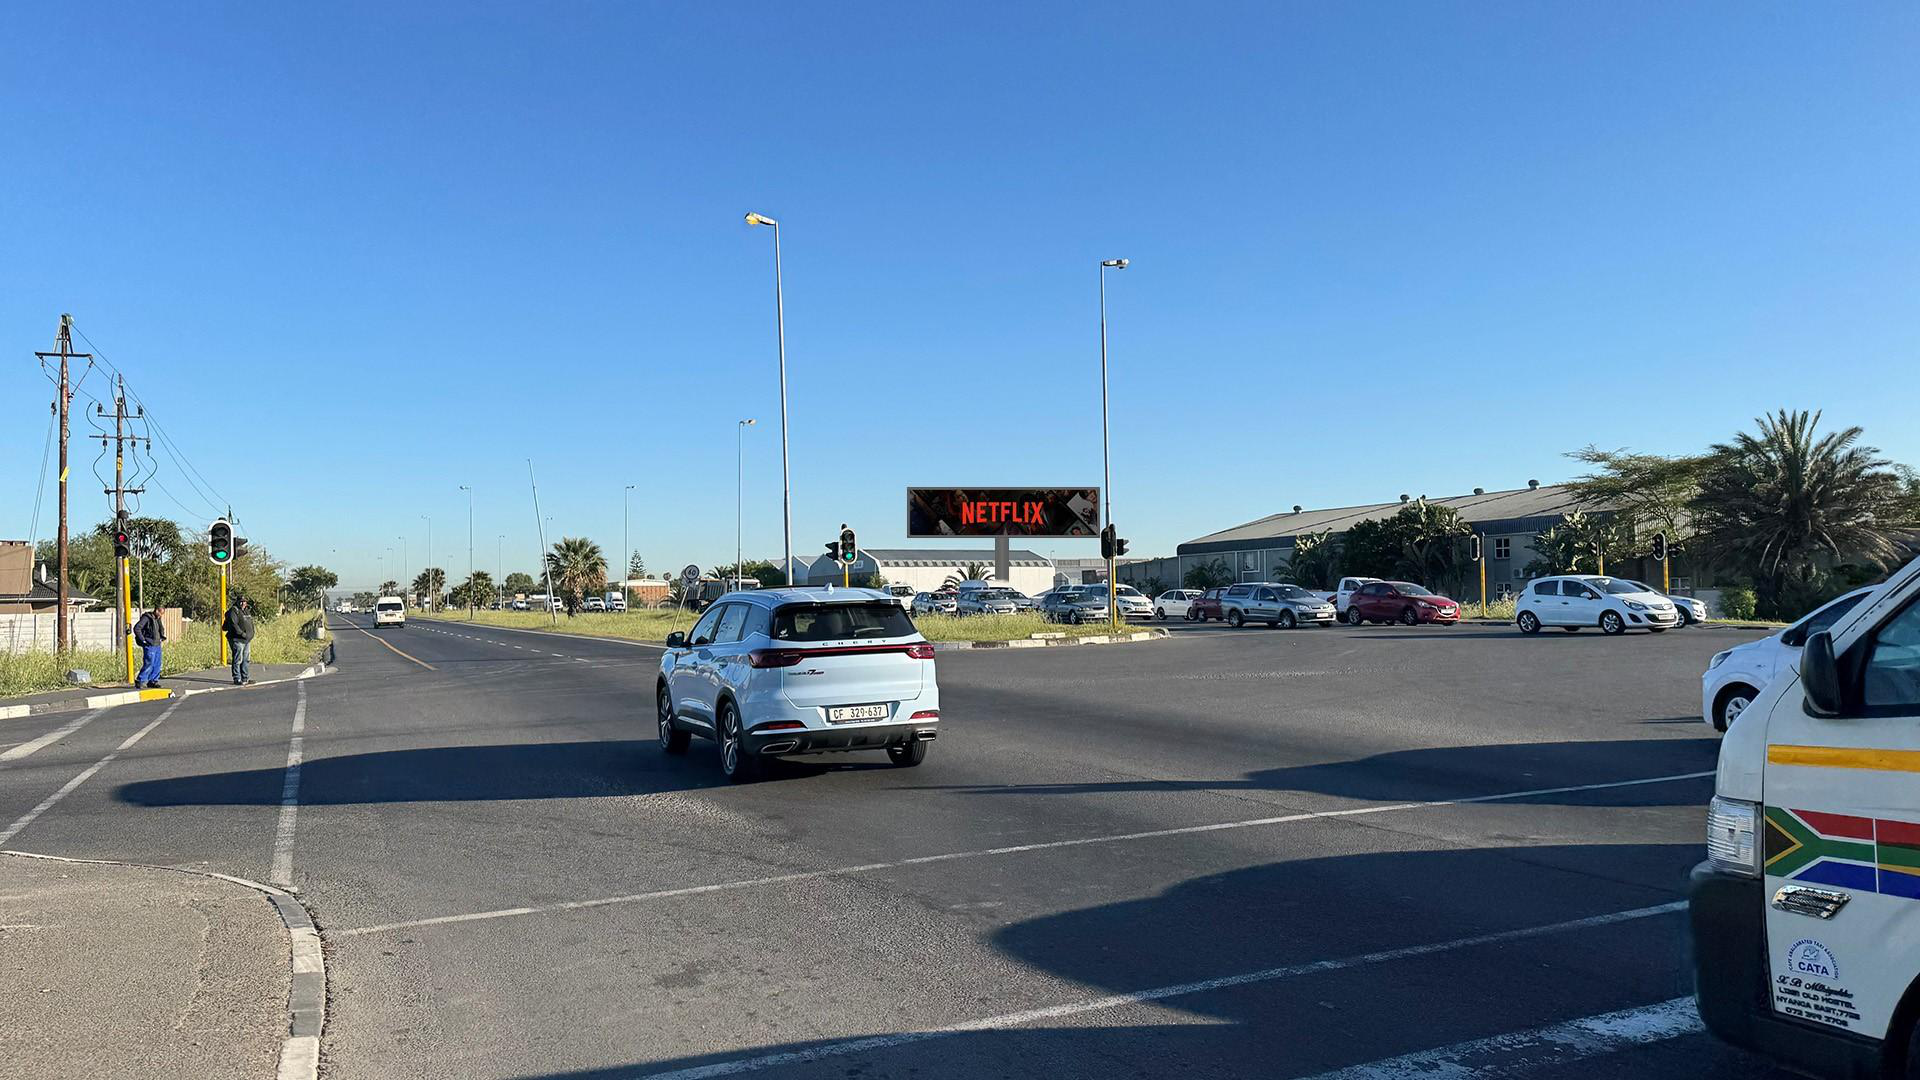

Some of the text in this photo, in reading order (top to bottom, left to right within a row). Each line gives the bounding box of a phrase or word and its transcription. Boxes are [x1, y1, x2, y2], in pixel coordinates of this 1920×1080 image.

[962, 501, 1044, 525] NETFLIX
[688, 568, 696, 576] 60
[833, 709, 844, 719] CF
[1798, 962, 1829, 975] CATA
[1802, 991, 1819, 1001] OLD
